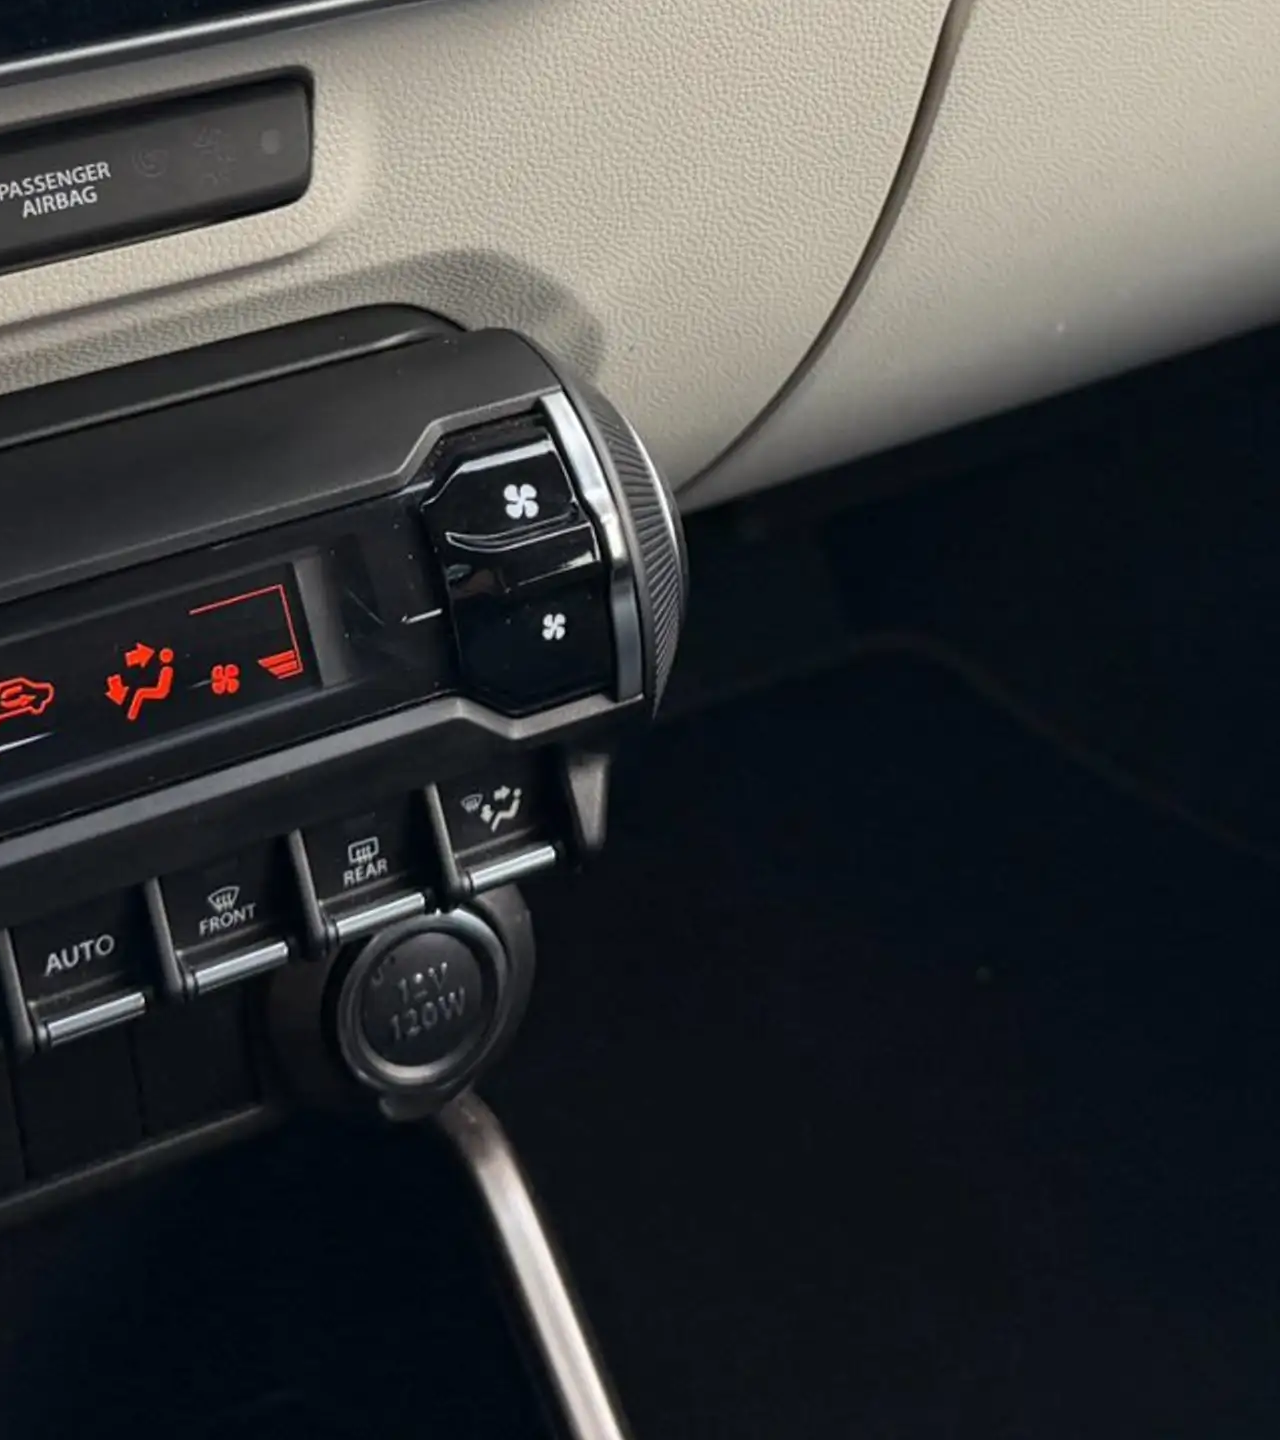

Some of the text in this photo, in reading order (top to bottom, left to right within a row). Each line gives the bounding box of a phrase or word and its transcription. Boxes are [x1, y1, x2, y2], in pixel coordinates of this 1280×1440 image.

[21, 185, 98, 219] AIRBAG
[343, 857, 388, 886] REAR
[198, 902, 257, 937] FRONT
[43, 934, 115, 976] AUTO
[390, 985, 466, 1041] 120W
